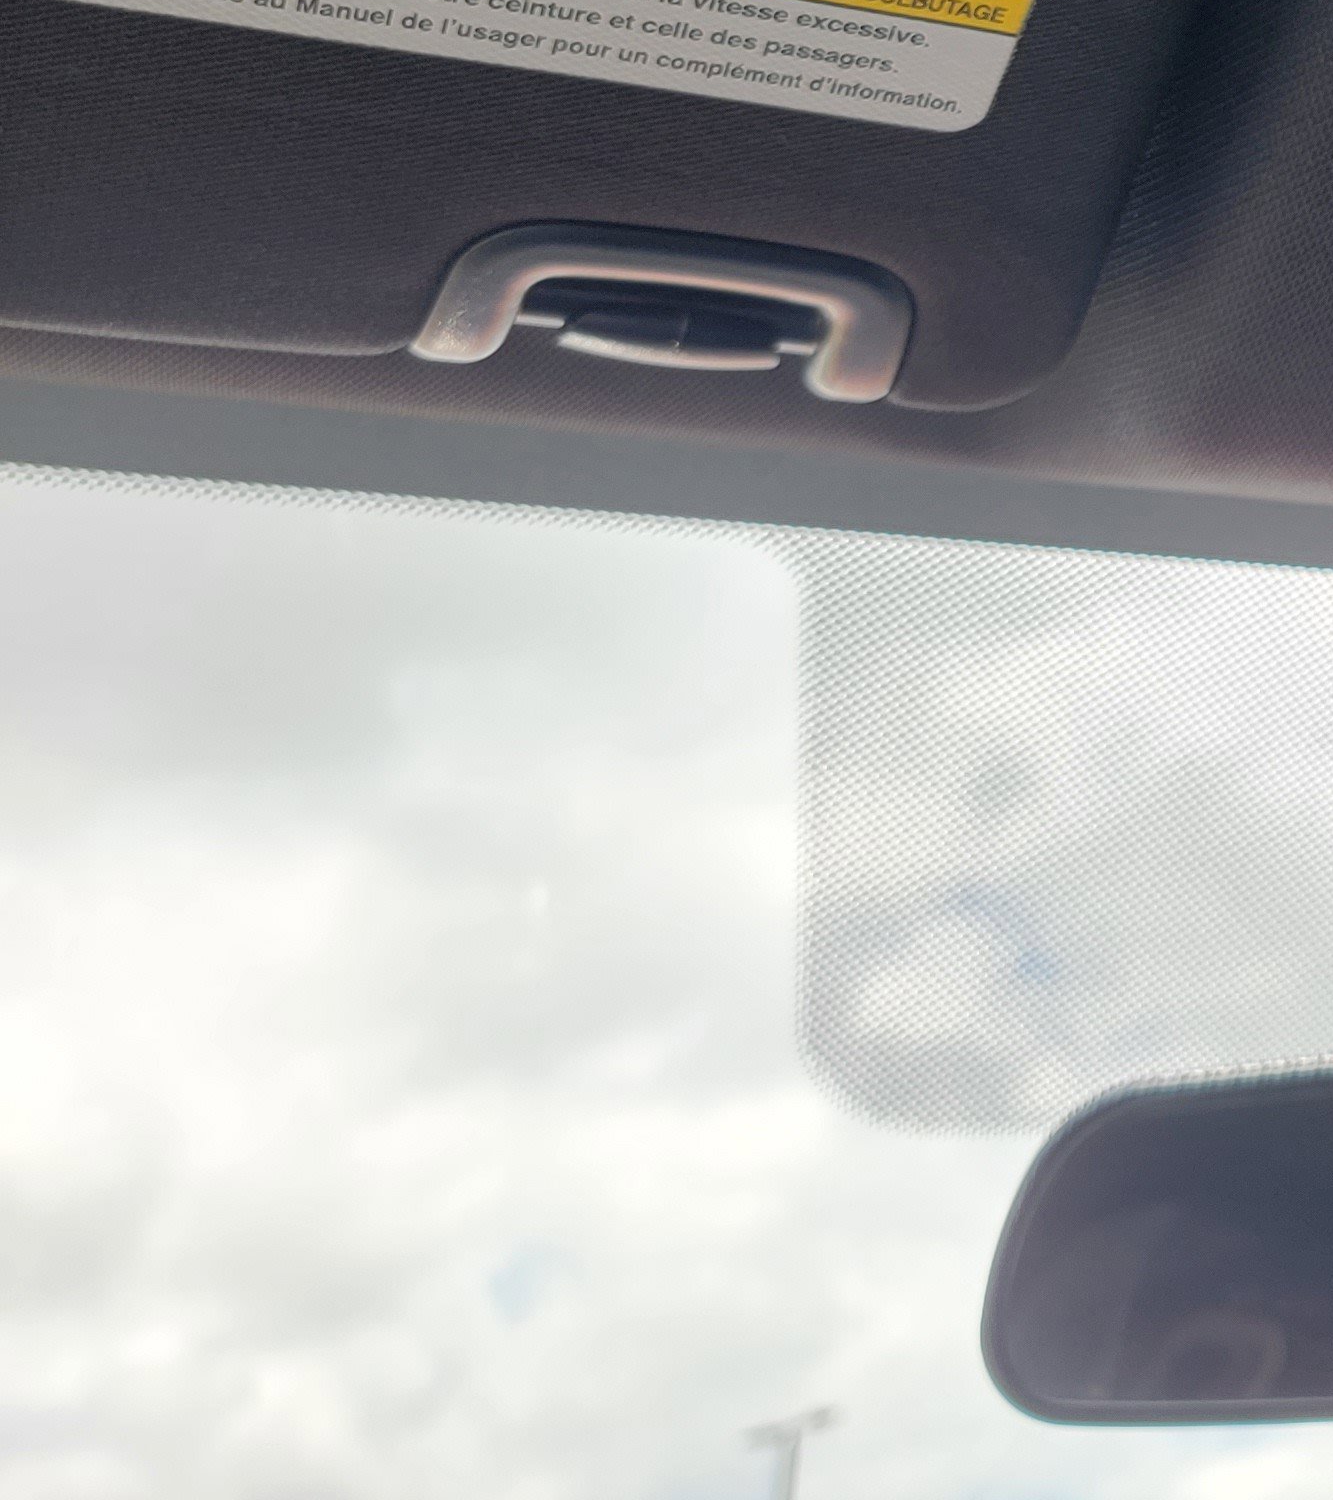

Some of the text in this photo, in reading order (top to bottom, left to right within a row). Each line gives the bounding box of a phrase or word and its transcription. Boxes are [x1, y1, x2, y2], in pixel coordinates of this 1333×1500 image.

[399, 12, 433, 32] de
[550, 38, 612, 58] pour
[617, 47, 648, 64] un
[655, 54, 802, 88] complément
[607, 14, 635, 30] et
[640, 19, 703, 41] celle
[708, 28, 757, 50] des
[762, 40, 896, 72] passagers.
[795, 13, 928, 47] excessive.
